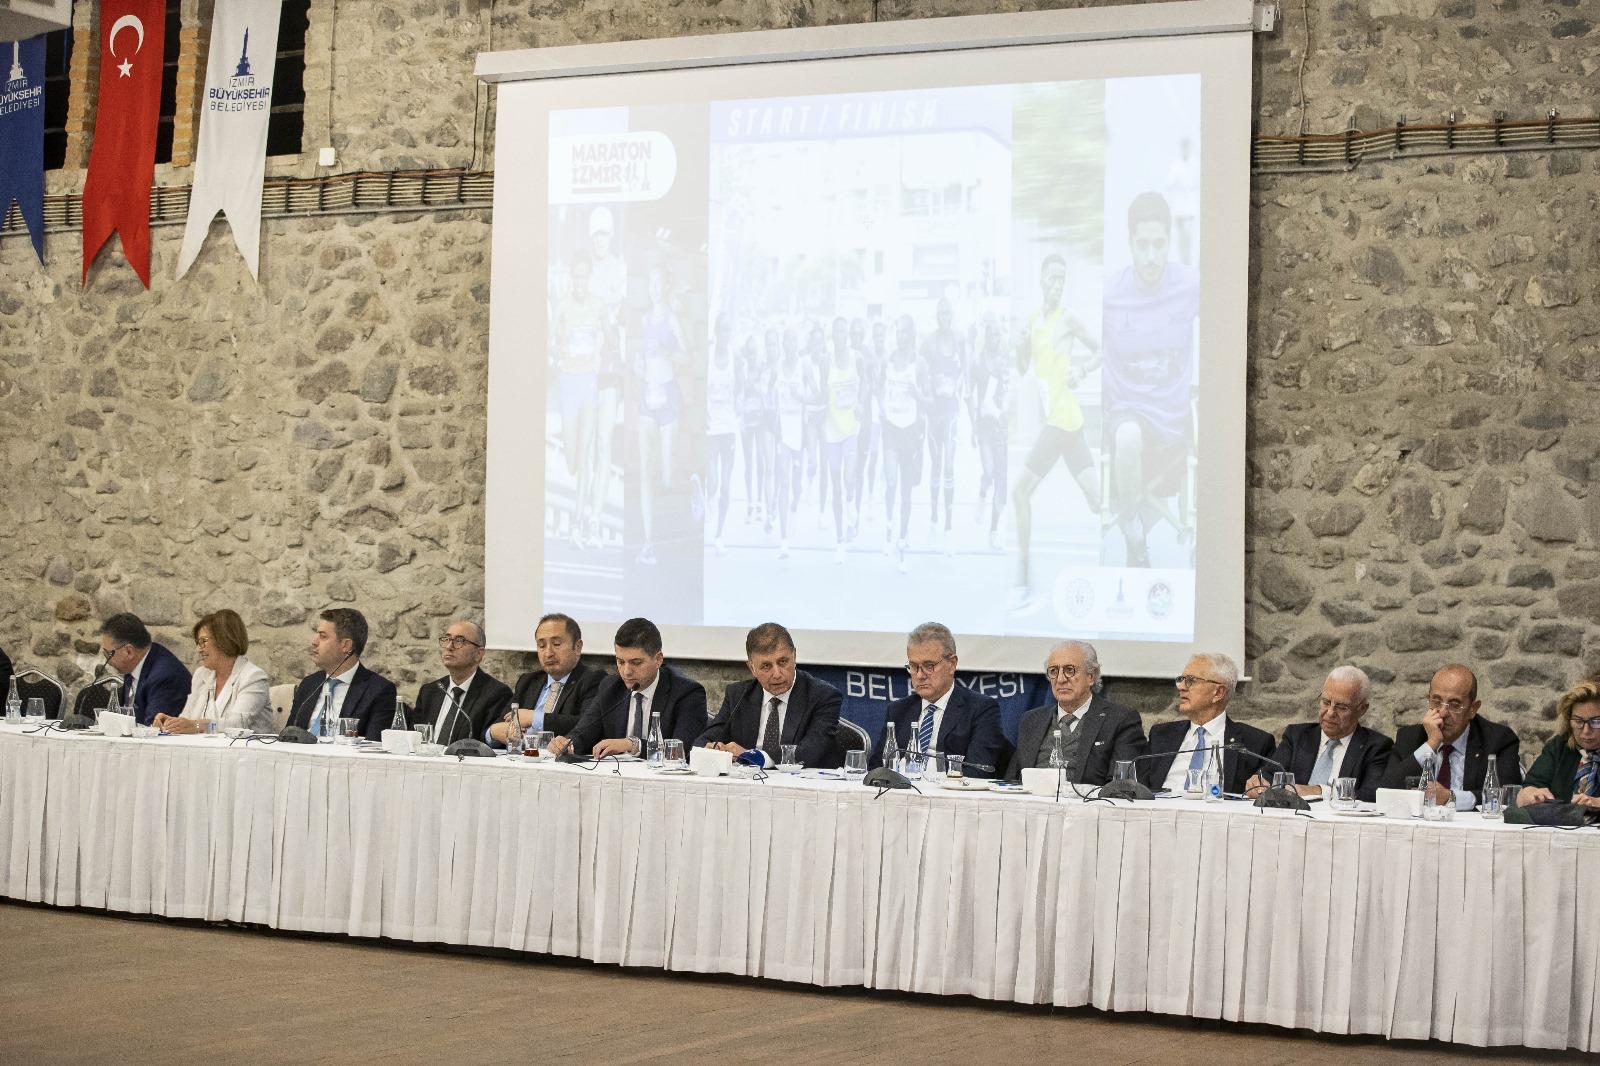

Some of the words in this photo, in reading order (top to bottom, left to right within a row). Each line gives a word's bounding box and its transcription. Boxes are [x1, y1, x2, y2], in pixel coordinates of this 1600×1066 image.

[0, 97, 40, 115] ELEDİYESİ
[728, 105, 811, 136] START
[840, 98, 938, 131] FINISH
[571, 141, 651, 161] MARATON
